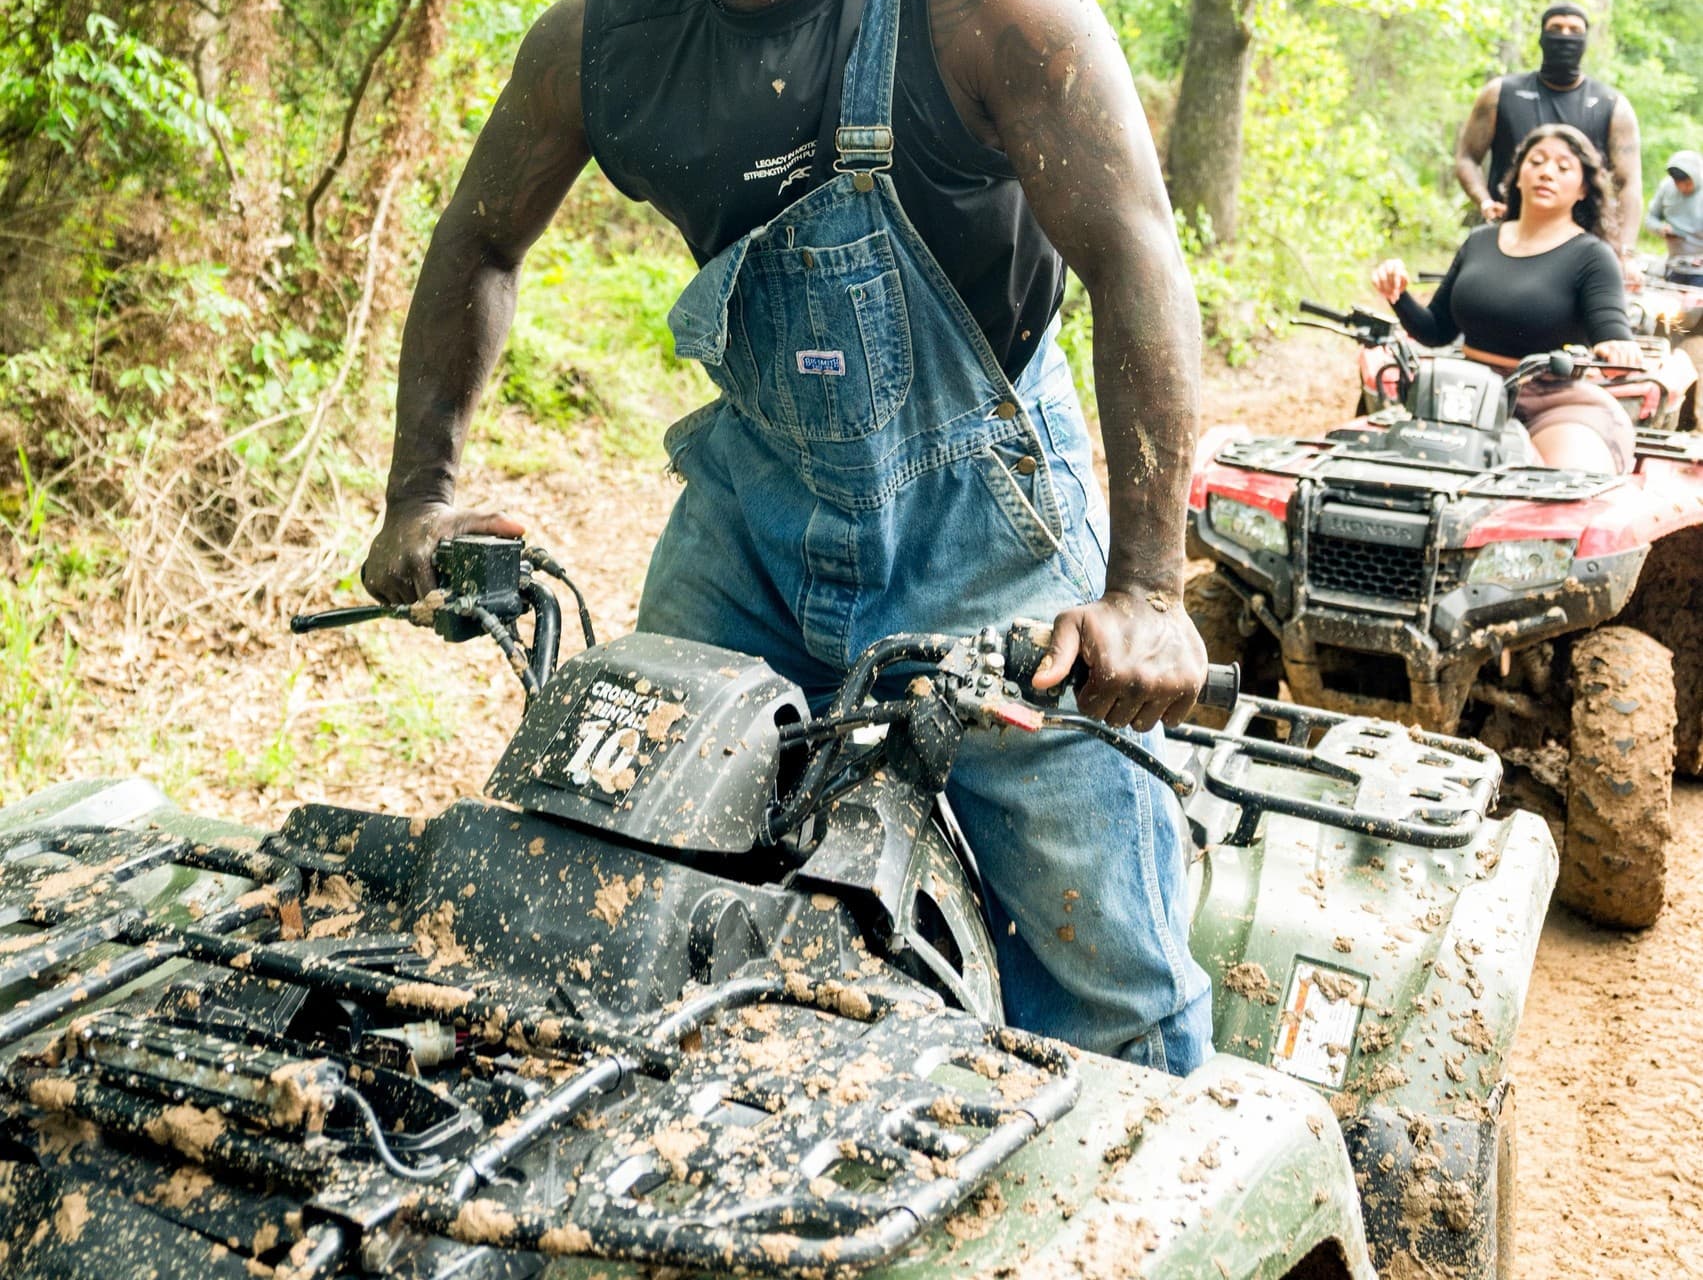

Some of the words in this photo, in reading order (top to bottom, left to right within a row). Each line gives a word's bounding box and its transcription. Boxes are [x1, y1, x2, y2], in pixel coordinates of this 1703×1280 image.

[743, 166, 787, 181] STRENGTH
[786, 153, 803, 169] WITH
[755, 155, 787, 169] LEGACY
[787, 151, 795, 160] IN
[1329, 516, 1414, 541] HONDA
[591, 681, 649, 708] CROSBY
[563, 719, 641, 787] 10
